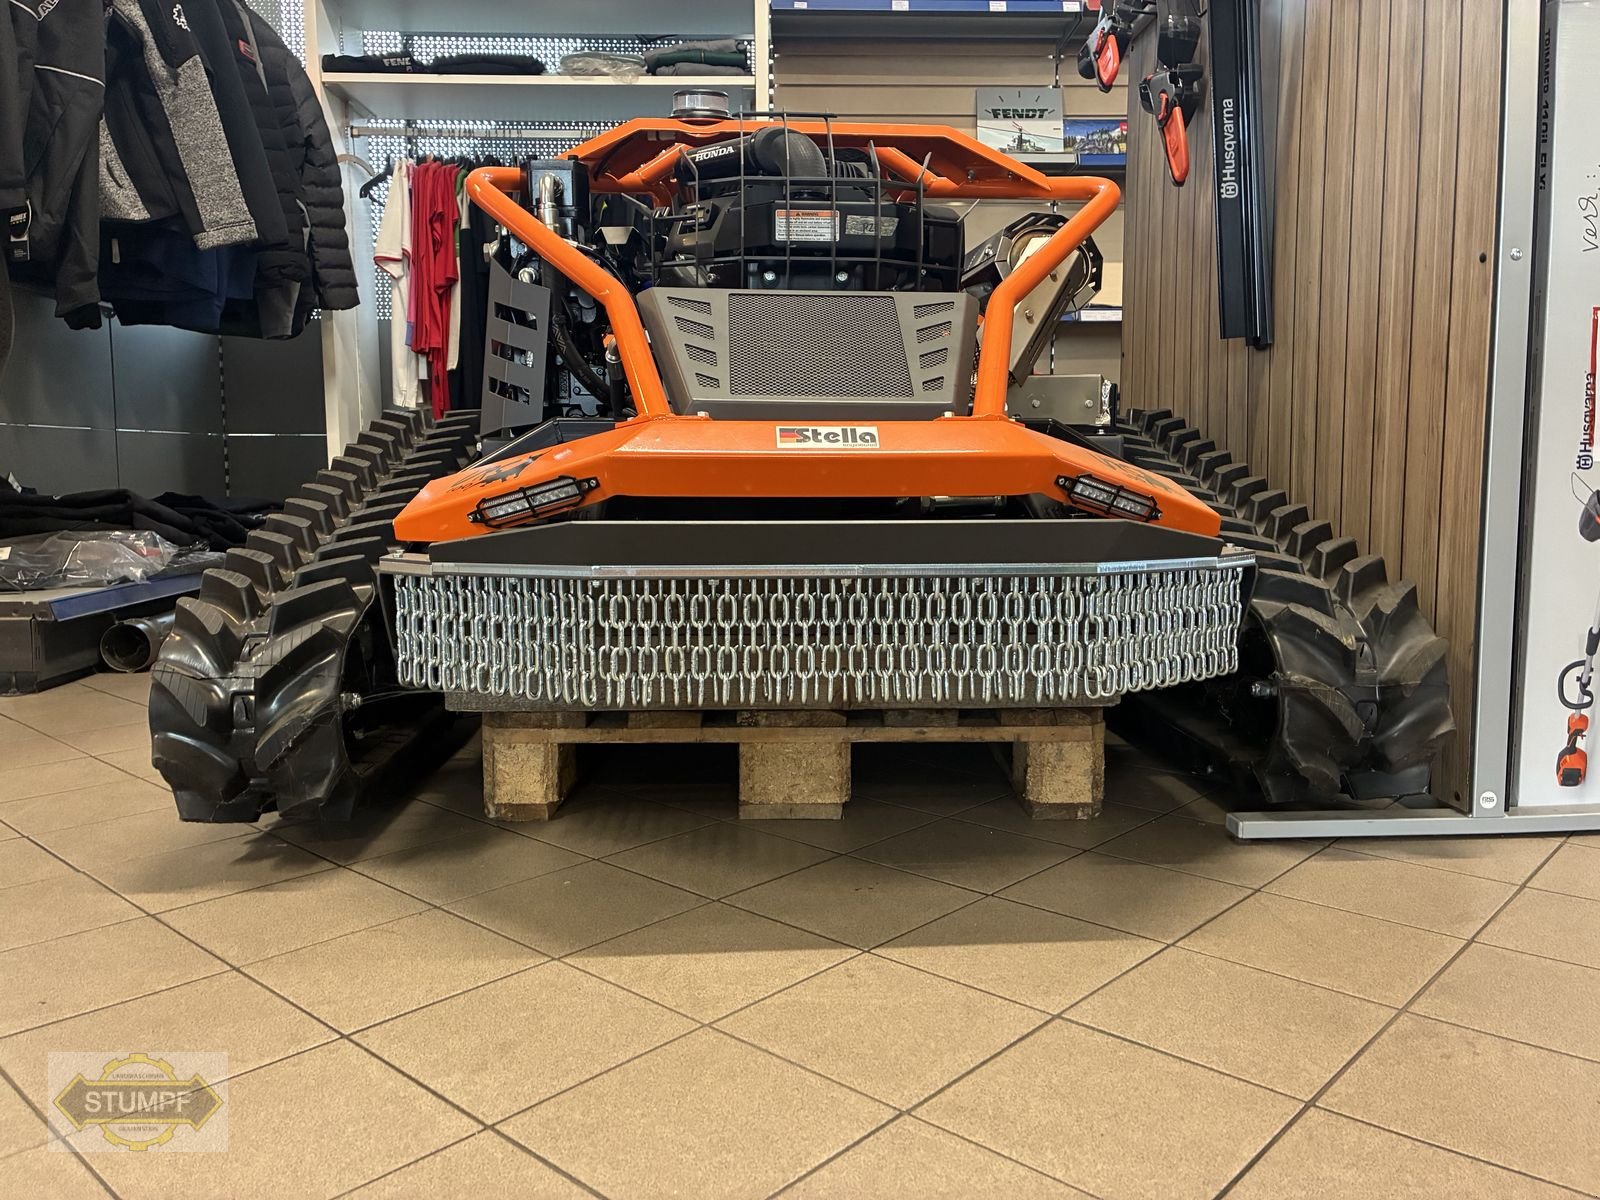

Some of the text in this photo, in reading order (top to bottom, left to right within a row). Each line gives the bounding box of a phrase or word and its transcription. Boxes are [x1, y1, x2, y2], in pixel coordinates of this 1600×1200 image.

[991, 108, 1049, 119] FENDT
[1222, 98, 1238, 181] Husqvarna
[695, 146, 735, 162] HONDA
[795, 428, 877, 443] Stella
